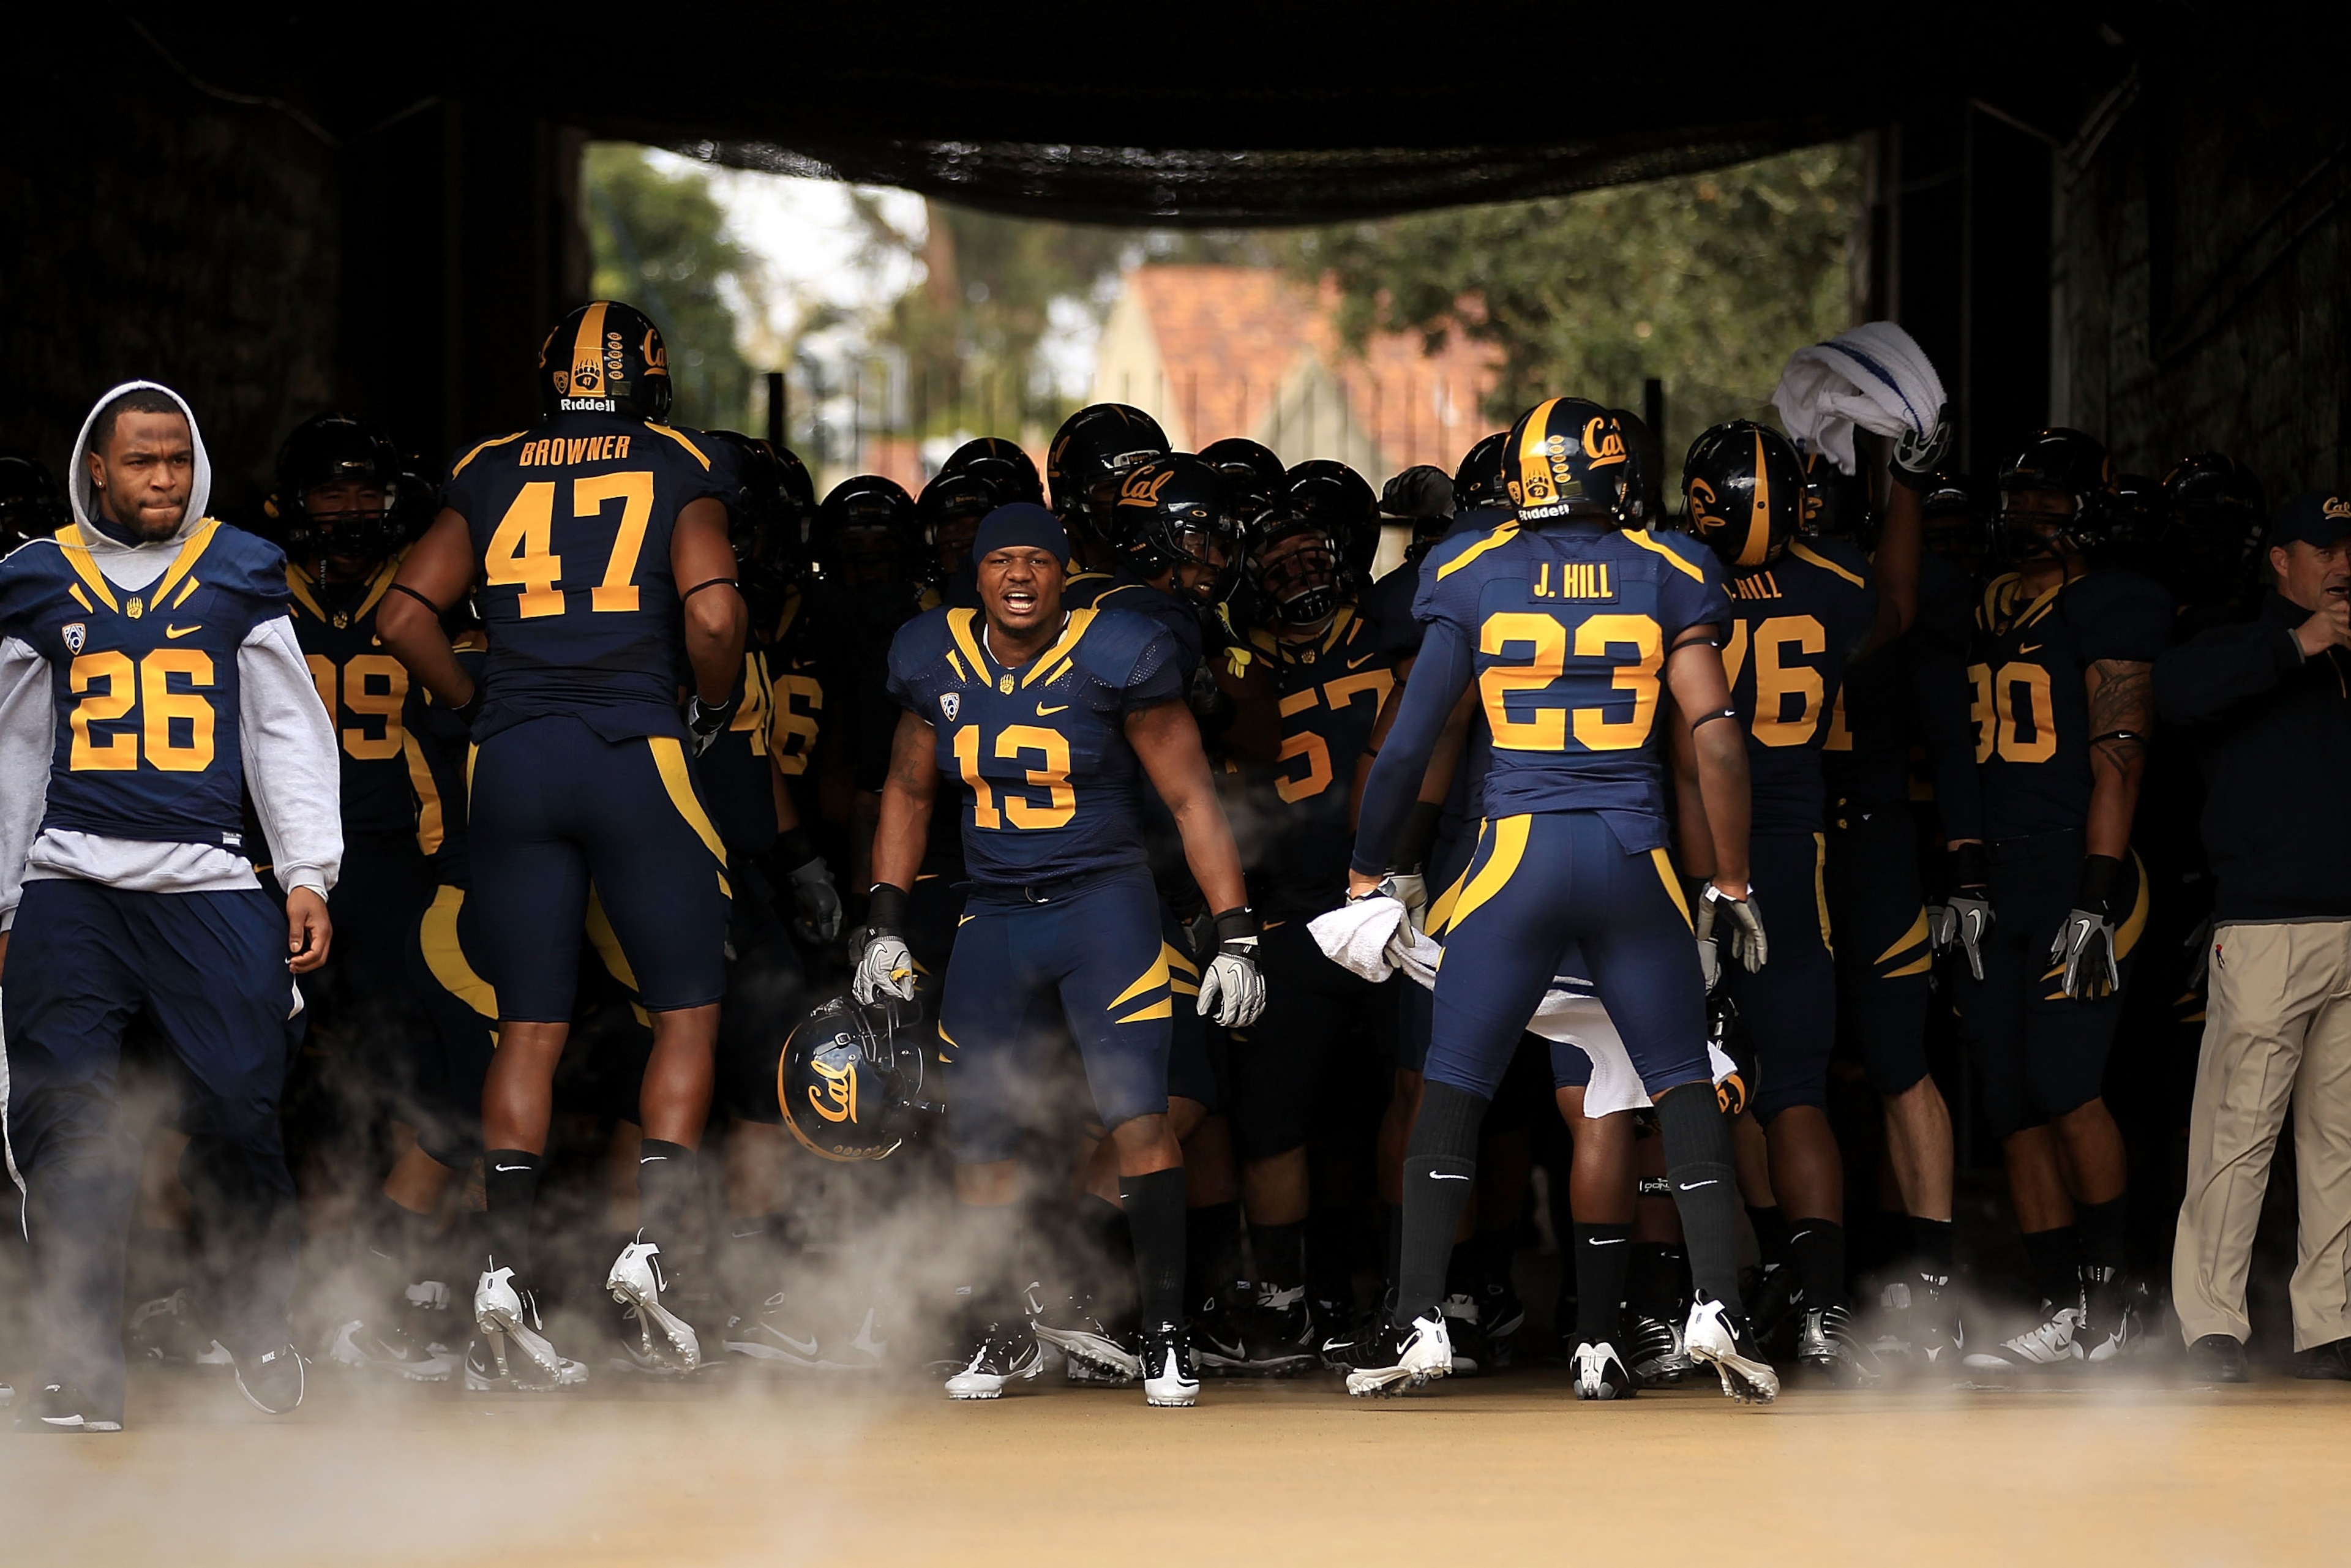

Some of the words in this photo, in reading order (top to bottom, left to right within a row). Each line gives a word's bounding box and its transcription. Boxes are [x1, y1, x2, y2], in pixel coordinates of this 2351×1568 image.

[560, 398, 615, 412] Riddell
[519, 435, 631, 467] BROWNER
[1116, 464, 1176, 508] Cal
[1518, 503, 1570, 521] Riddell
[484, 471, 654, 619] 47
[1533, 563, 1556, 598] J.
[1563, 563, 1613, 599] HILL
[1733, 570, 1783, 600] HILL
[1479, 612, 1665, 751] 23
[69, 648, 216, 772] 26
[953, 724, 1076, 830] 13
[808, 1060, 858, 1125] Cal
[261, 1351, 276, 1364] NIKE
